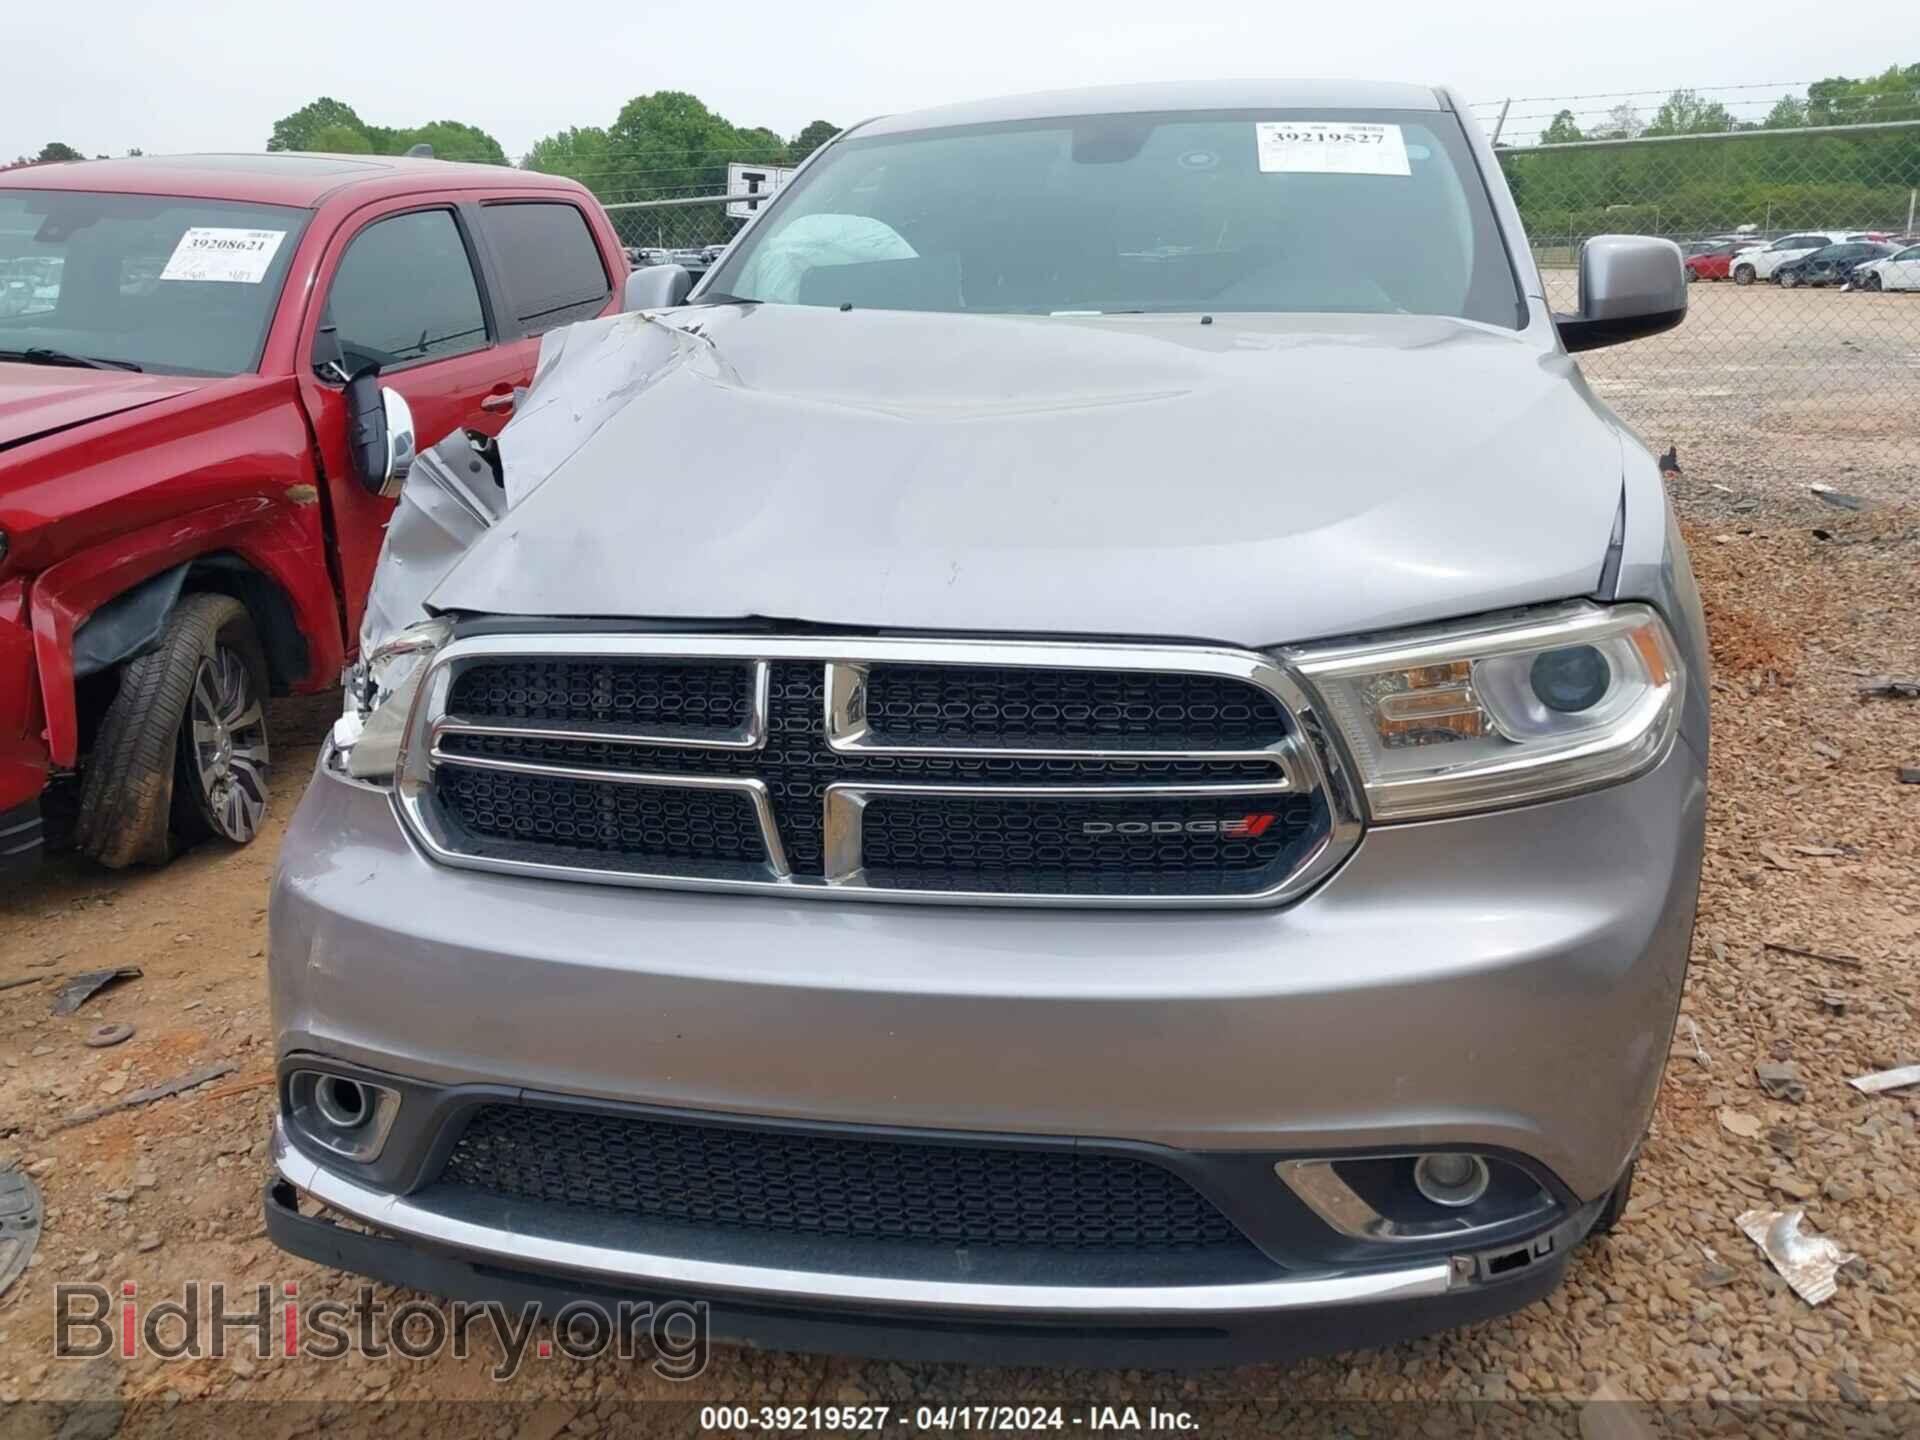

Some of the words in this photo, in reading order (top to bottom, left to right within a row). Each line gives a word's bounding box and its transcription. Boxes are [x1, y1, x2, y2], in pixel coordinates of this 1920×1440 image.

[1272, 132, 1385, 145] 39219527
[741, 172, 766, 210] T
[187, 238, 265, 251] 39208621
[1082, 819, 1249, 834] DODGE
